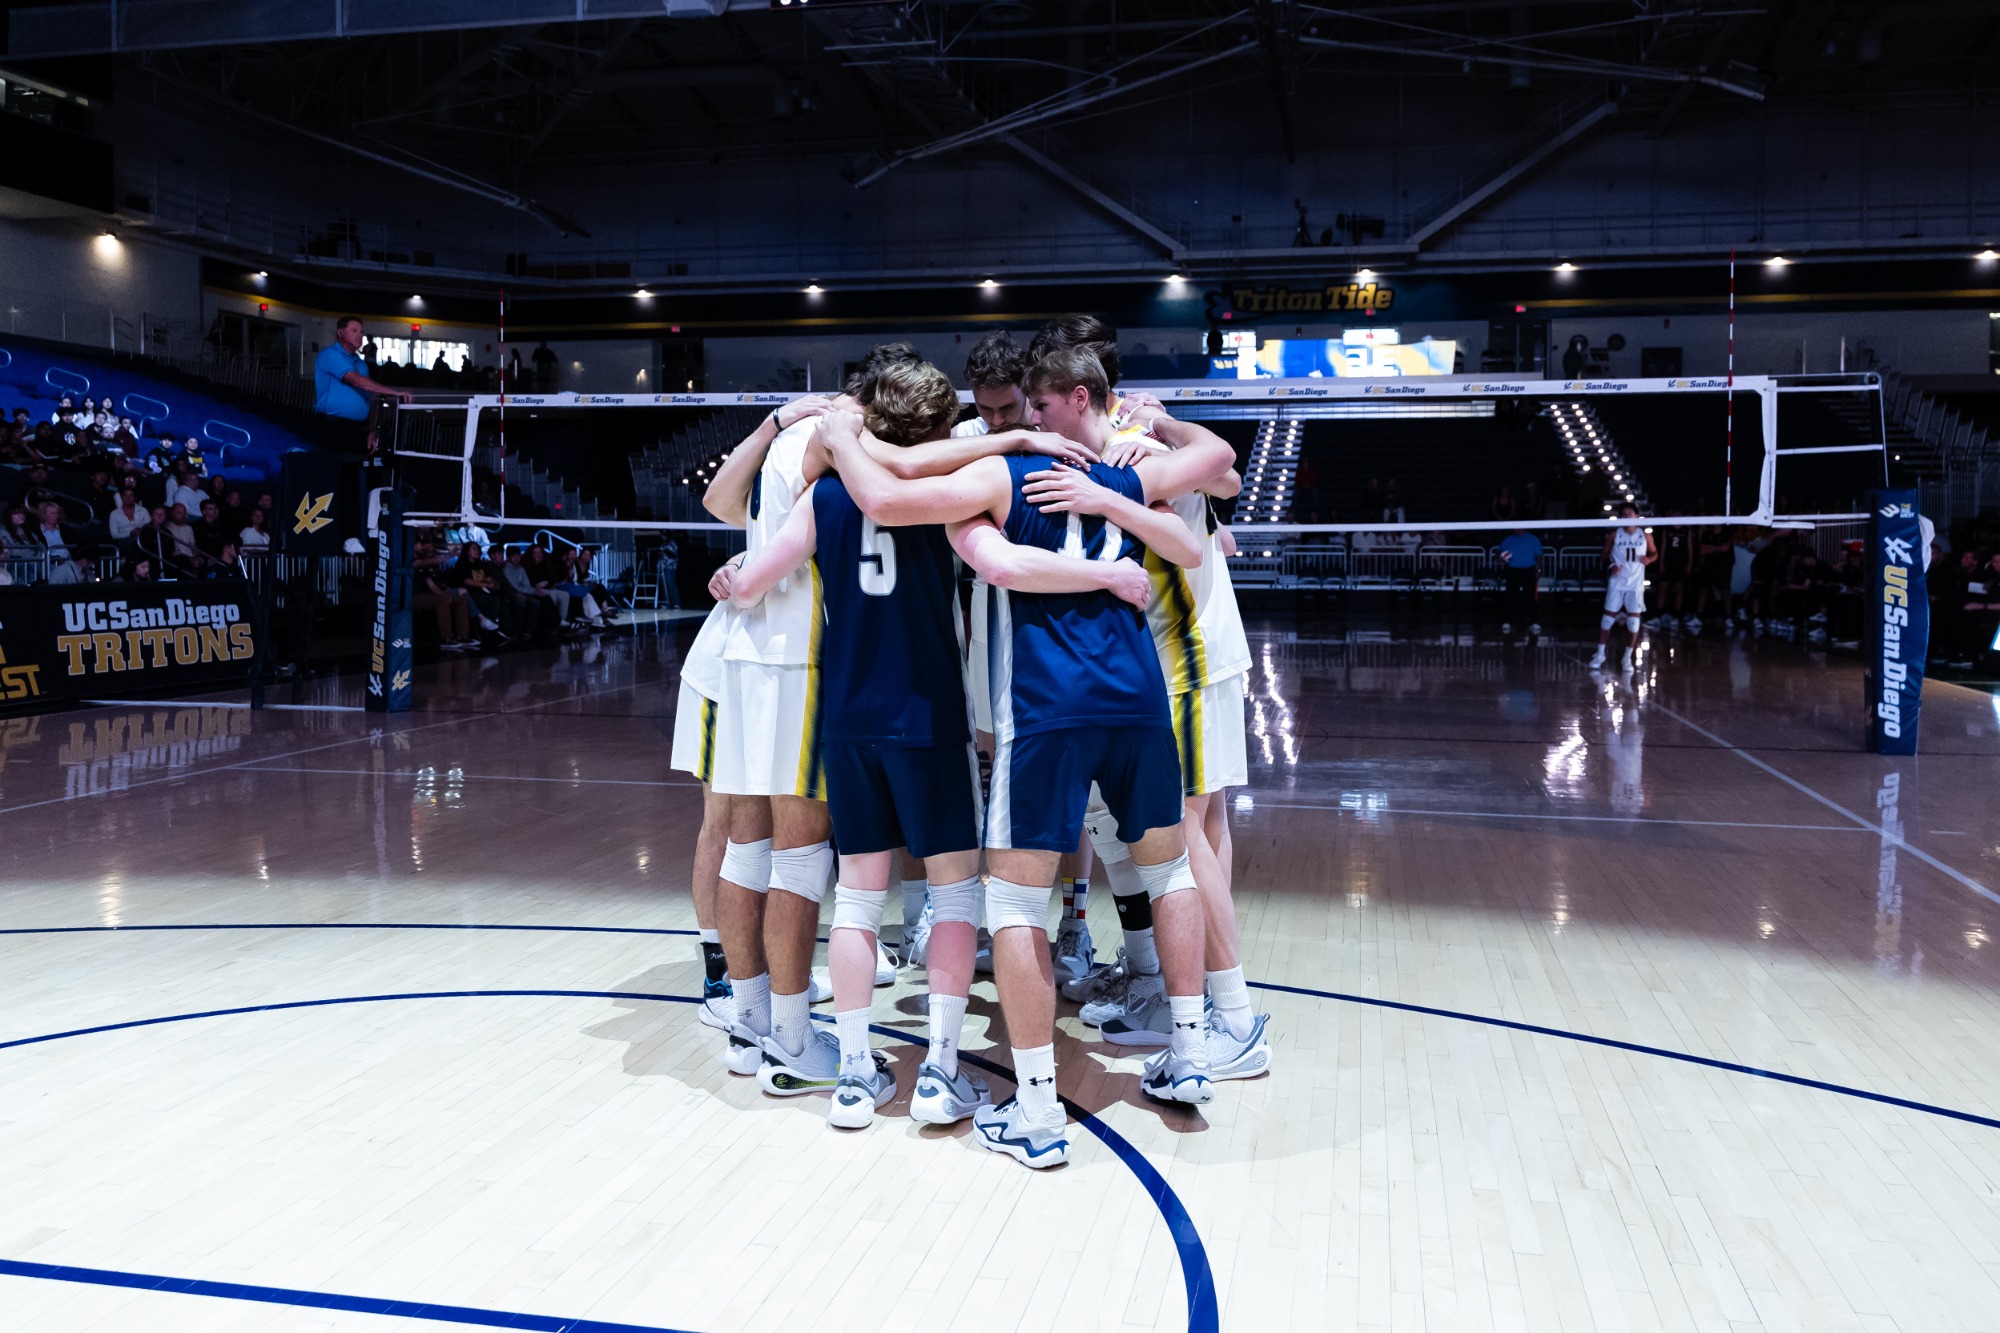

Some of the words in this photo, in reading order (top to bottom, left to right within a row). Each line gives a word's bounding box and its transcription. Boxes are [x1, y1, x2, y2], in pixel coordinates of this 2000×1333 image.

[1234, 287, 1322, 311] Triton
[1326, 283, 1392, 309] Tide
[858, 513, 897, 596] 5
[1626, 547, 1636, 562] 11
[1672, 536, 1680, 548] 2
[57, 623, 255, 676] TRITONS
